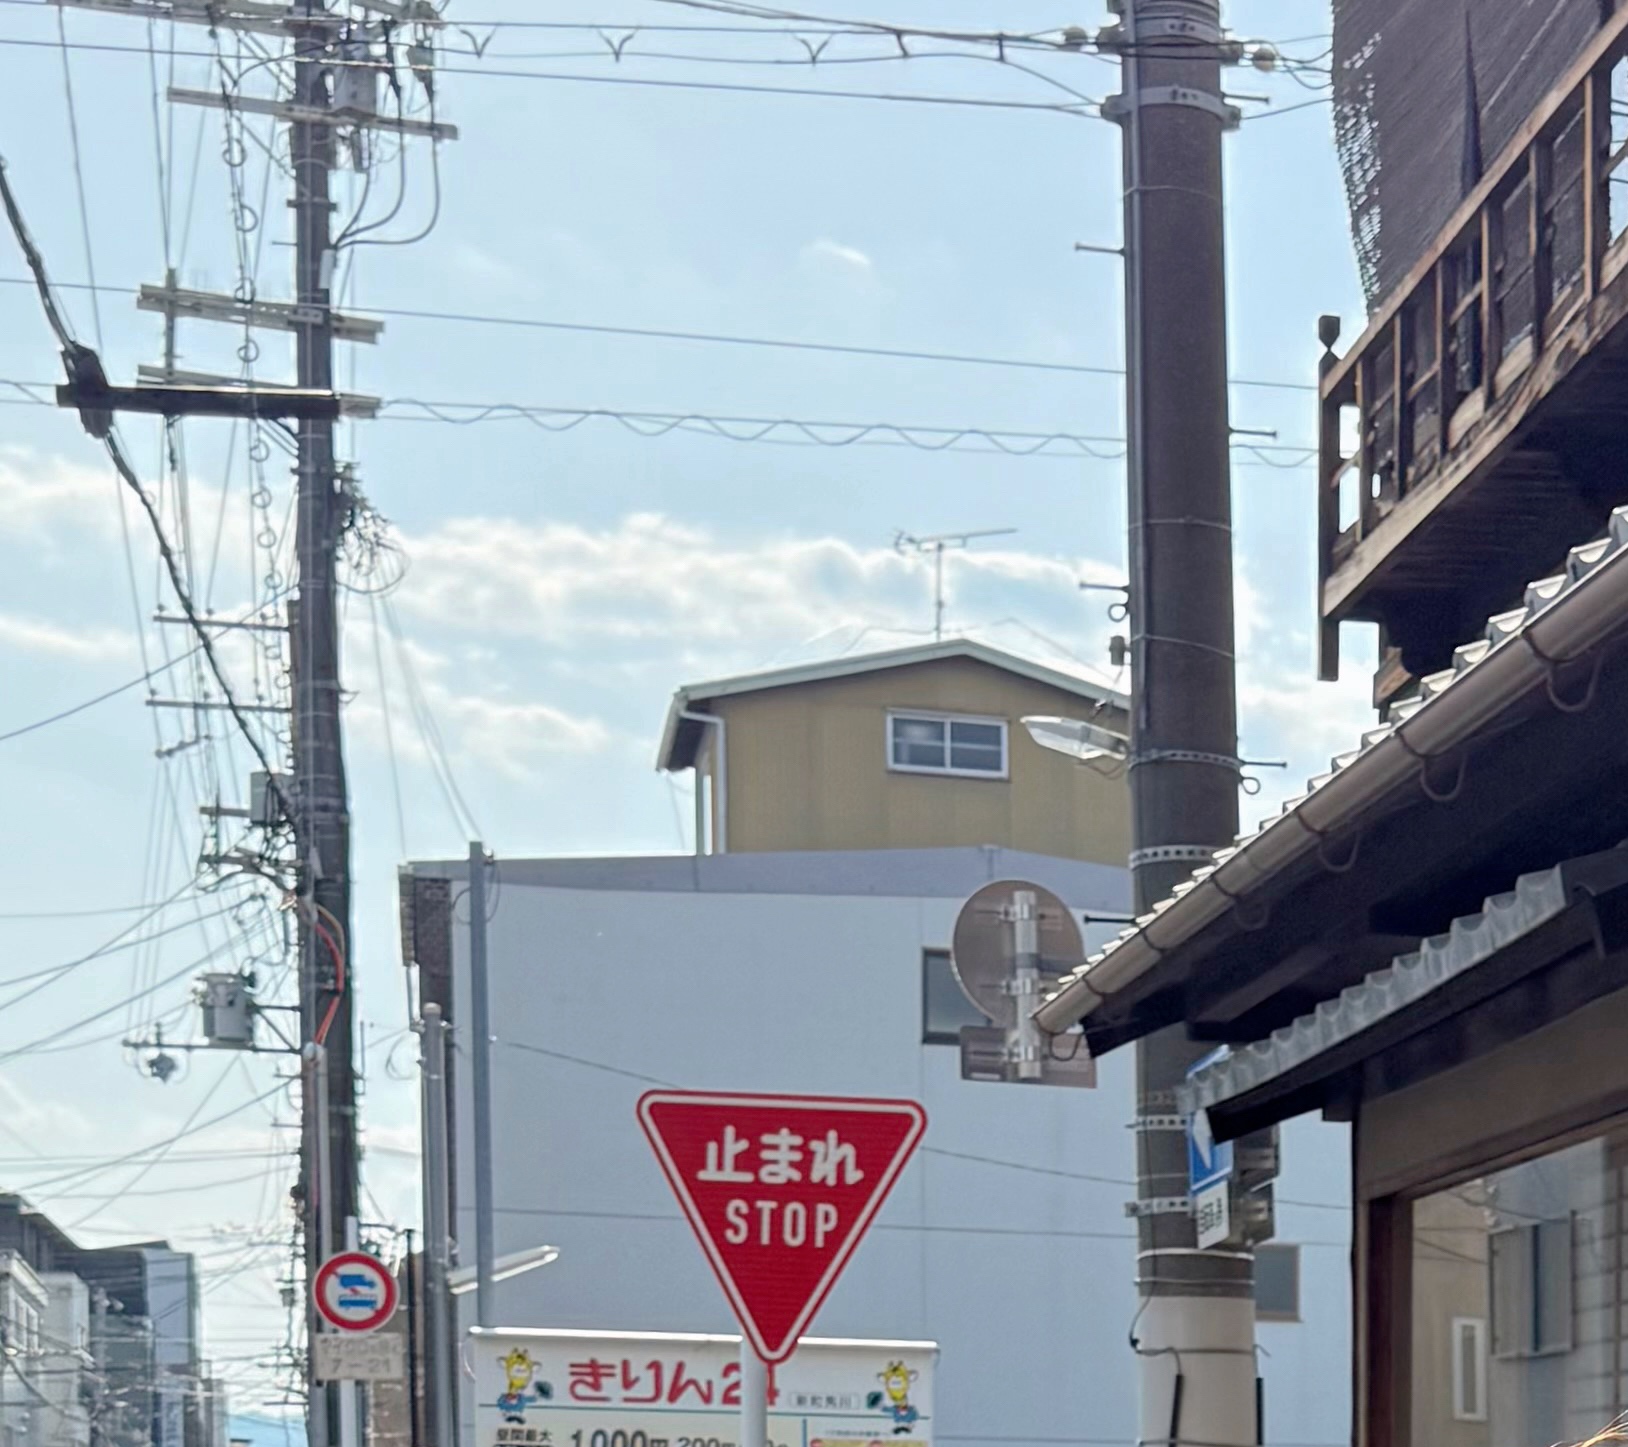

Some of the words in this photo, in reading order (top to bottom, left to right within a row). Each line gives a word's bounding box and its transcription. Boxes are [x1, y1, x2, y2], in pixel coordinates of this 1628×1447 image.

[697, 1125, 864, 1186] 止まれ
[725, 1199, 838, 1248] STOP
